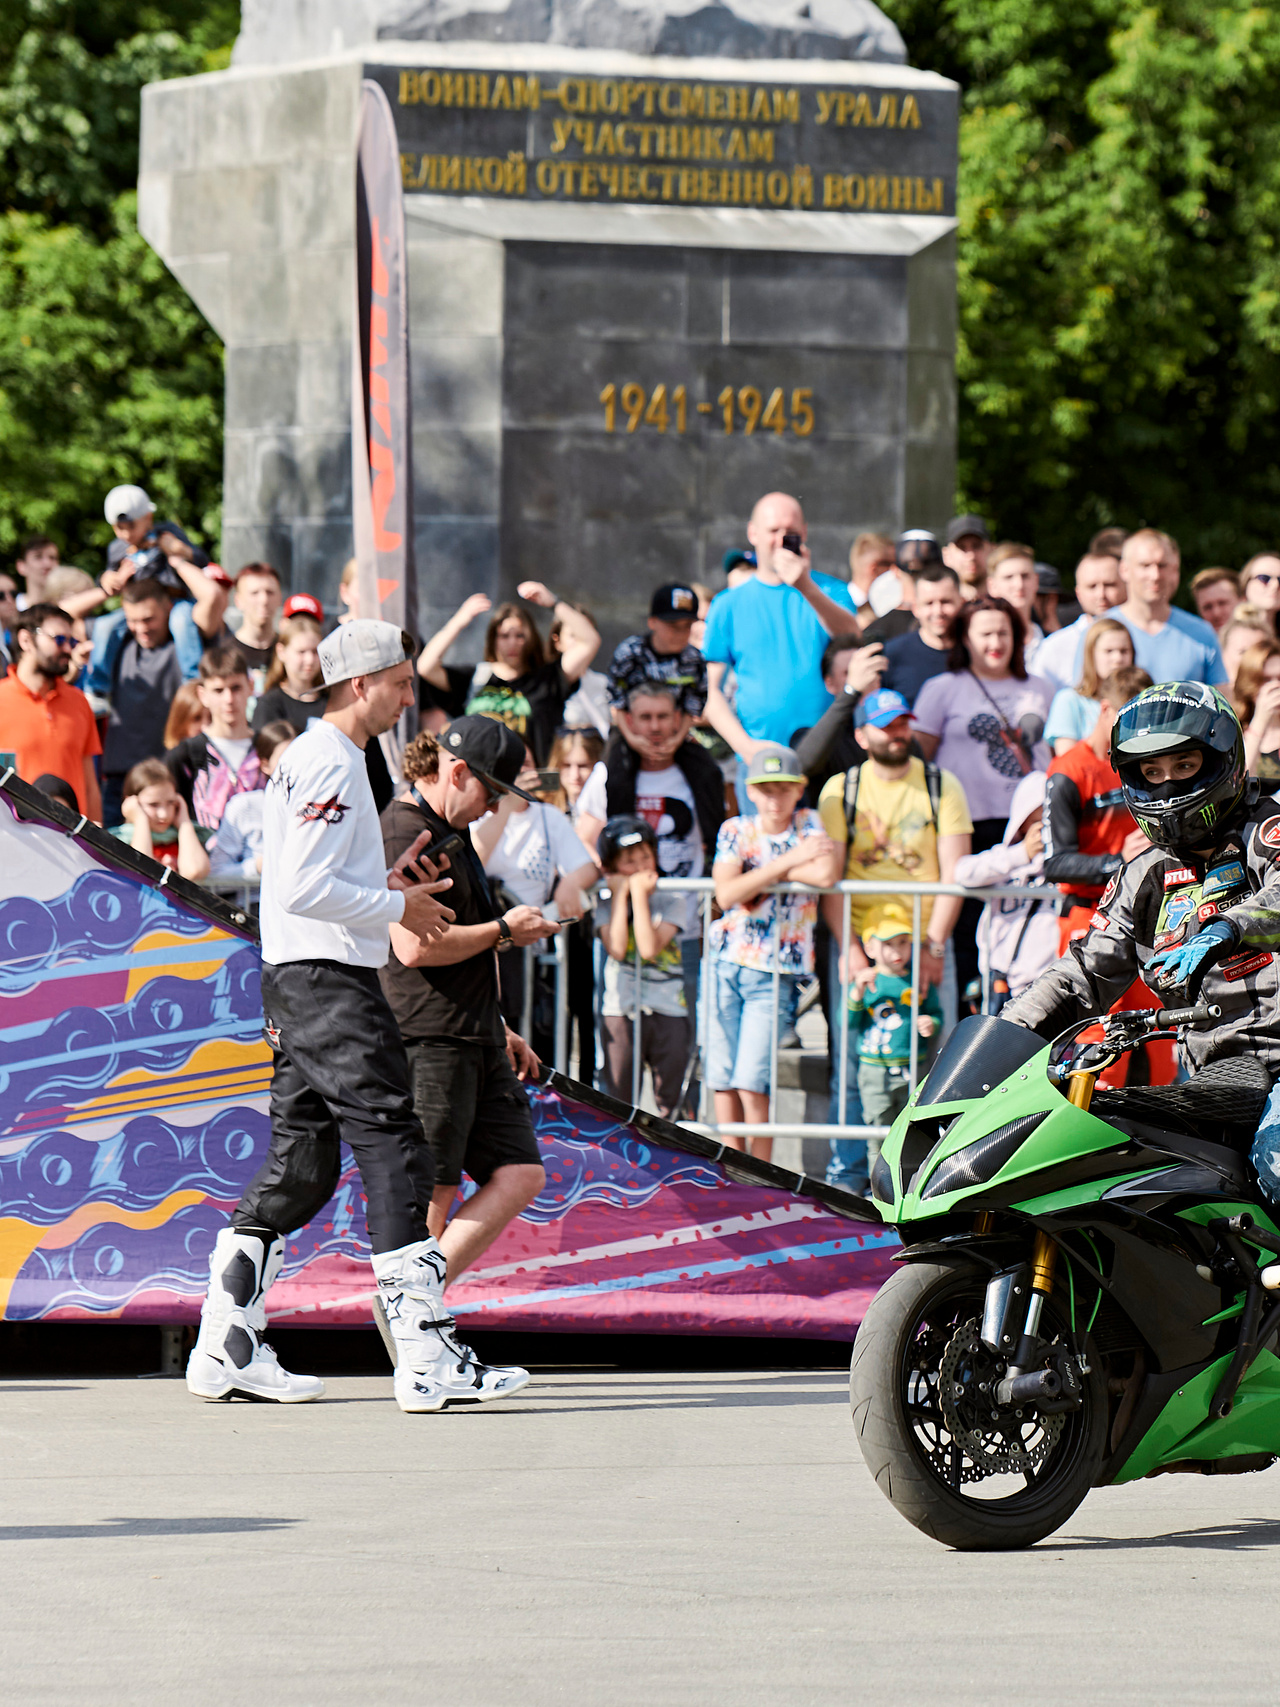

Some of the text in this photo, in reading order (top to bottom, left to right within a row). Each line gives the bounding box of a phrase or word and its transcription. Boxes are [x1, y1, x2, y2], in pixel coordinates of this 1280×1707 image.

[815, 91, 922, 130] УРАЛА
[551, 118, 774, 163] УЧАСТНИКАМ
[400, 150, 527, 195] ЕЛИКОЙ
[536, 161, 813, 207] ОТЕЧЕСТВЕННОЙ
[600, 382, 815, 436] 1941-1945
[1164, 868, 1196, 886] OTUL
